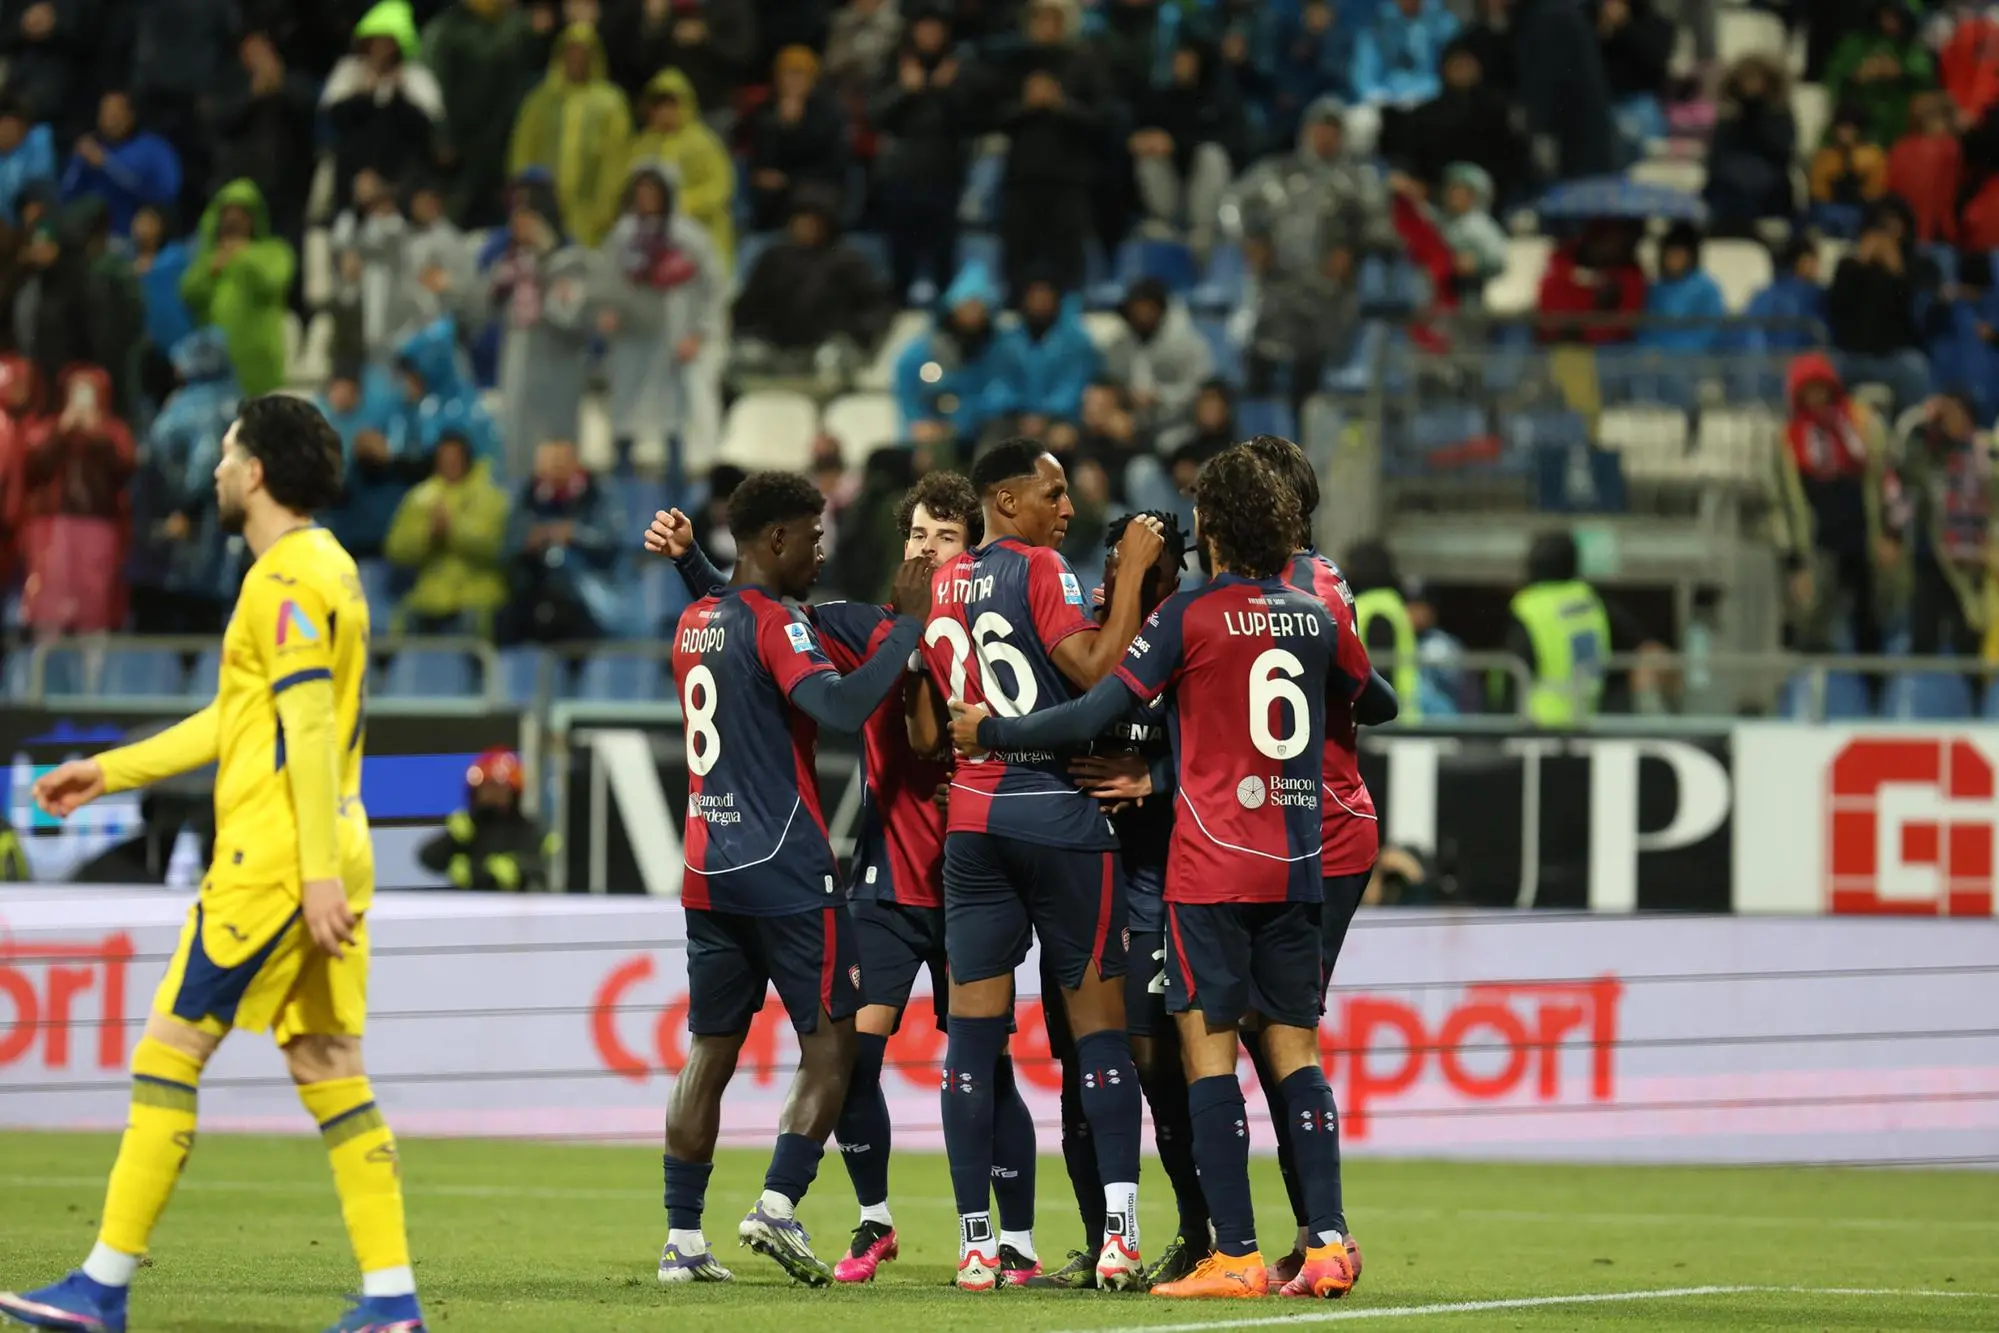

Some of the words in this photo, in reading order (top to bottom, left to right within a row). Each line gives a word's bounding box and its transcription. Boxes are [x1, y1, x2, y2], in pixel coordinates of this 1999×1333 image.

[953, 575, 994, 604] MNA
[1224, 611, 1320, 637] LUPERTO
[681, 627, 725, 653] ADOPO
[925, 611, 1038, 718] 26
[1249, 648, 1310, 760] 6
[685, 664, 720, 776] 8
[1270, 776, 1312, 791] Banco
